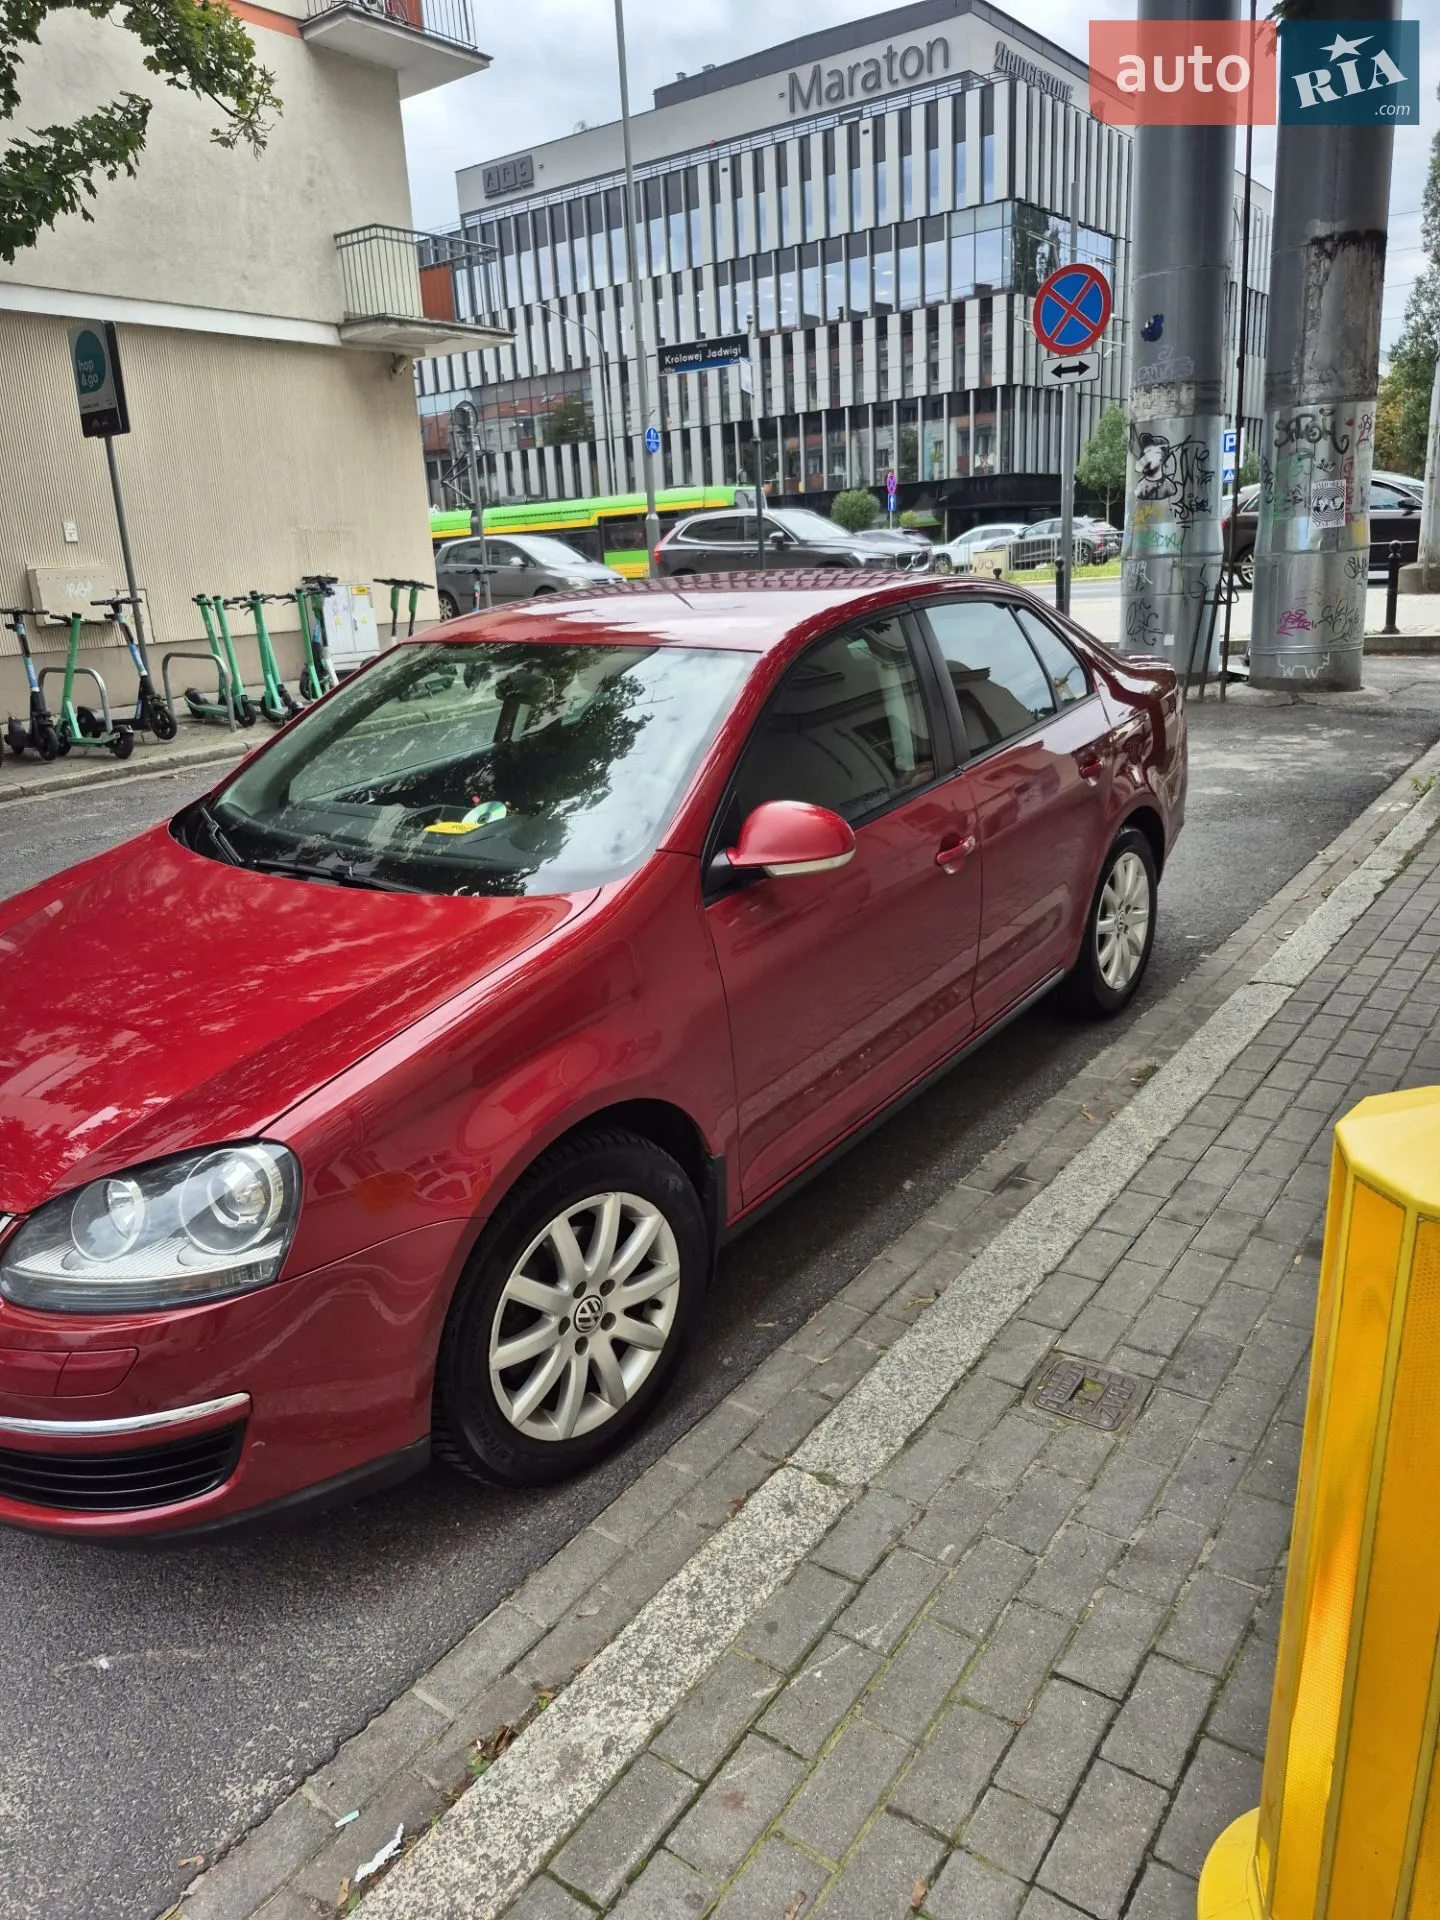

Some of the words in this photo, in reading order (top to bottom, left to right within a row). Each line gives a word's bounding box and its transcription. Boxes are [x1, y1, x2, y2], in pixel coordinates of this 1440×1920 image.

[788, 37, 949, 113] Maraton
[664, 351, 702, 365] Królowej
[706, 345, 742, 358] Jadwigi
[78, 360, 94, 373] hop
